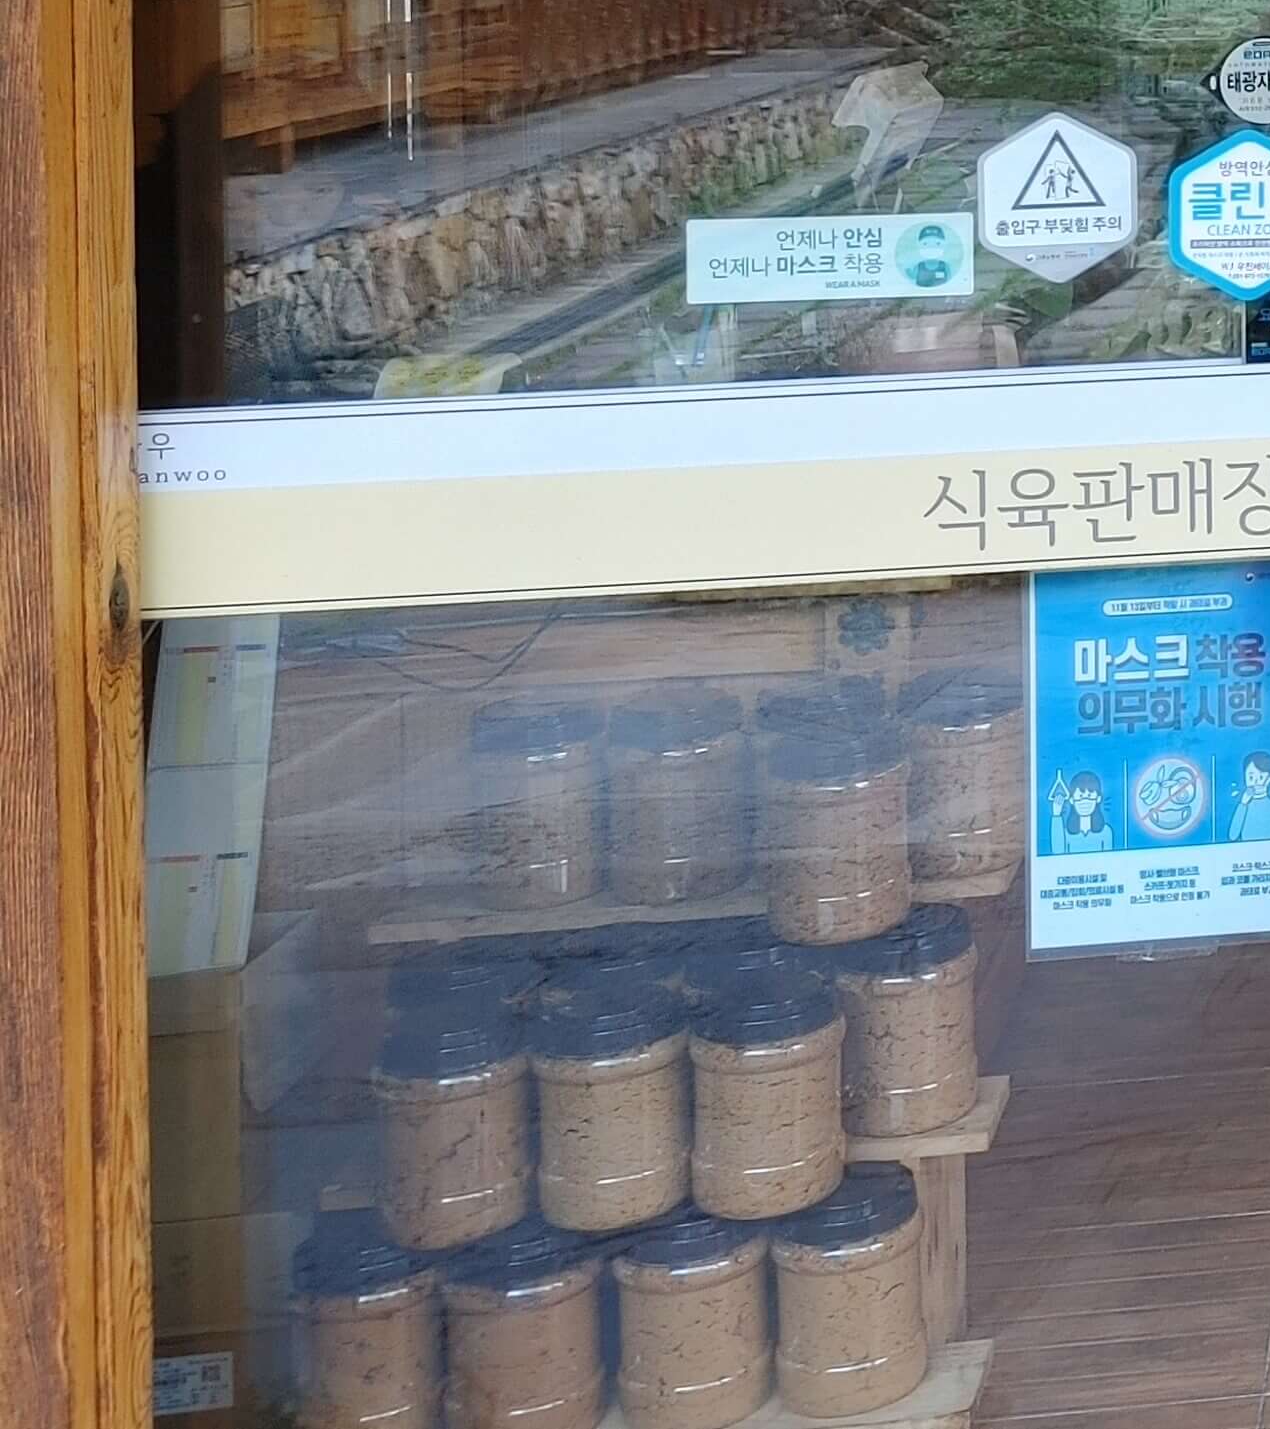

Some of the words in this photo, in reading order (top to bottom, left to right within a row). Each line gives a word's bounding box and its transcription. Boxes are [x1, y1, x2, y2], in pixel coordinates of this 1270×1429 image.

[1044, 217, 1088, 233] 부딪힘
[1092, 215, 1122, 231] 주의
[1207, 224, 1250, 236] CLEAN
[776, 228, 836, 251] 언제나
[843, 227, 882, 248] 안심
[708, 256, 771, 278] 언제나
[777, 255, 837, 276] 마스크
[843, 252, 882, 274] 착용
[138, 433, 175, 460] 우
[138, 468, 227, 484] anwoo
[1074, 634, 1189, 685] 마스크
[1195, 632, 1266, 679] 착용
[1078, 686, 1187, 735] 의무화
[1192, 681, 1263, 728] 시행
